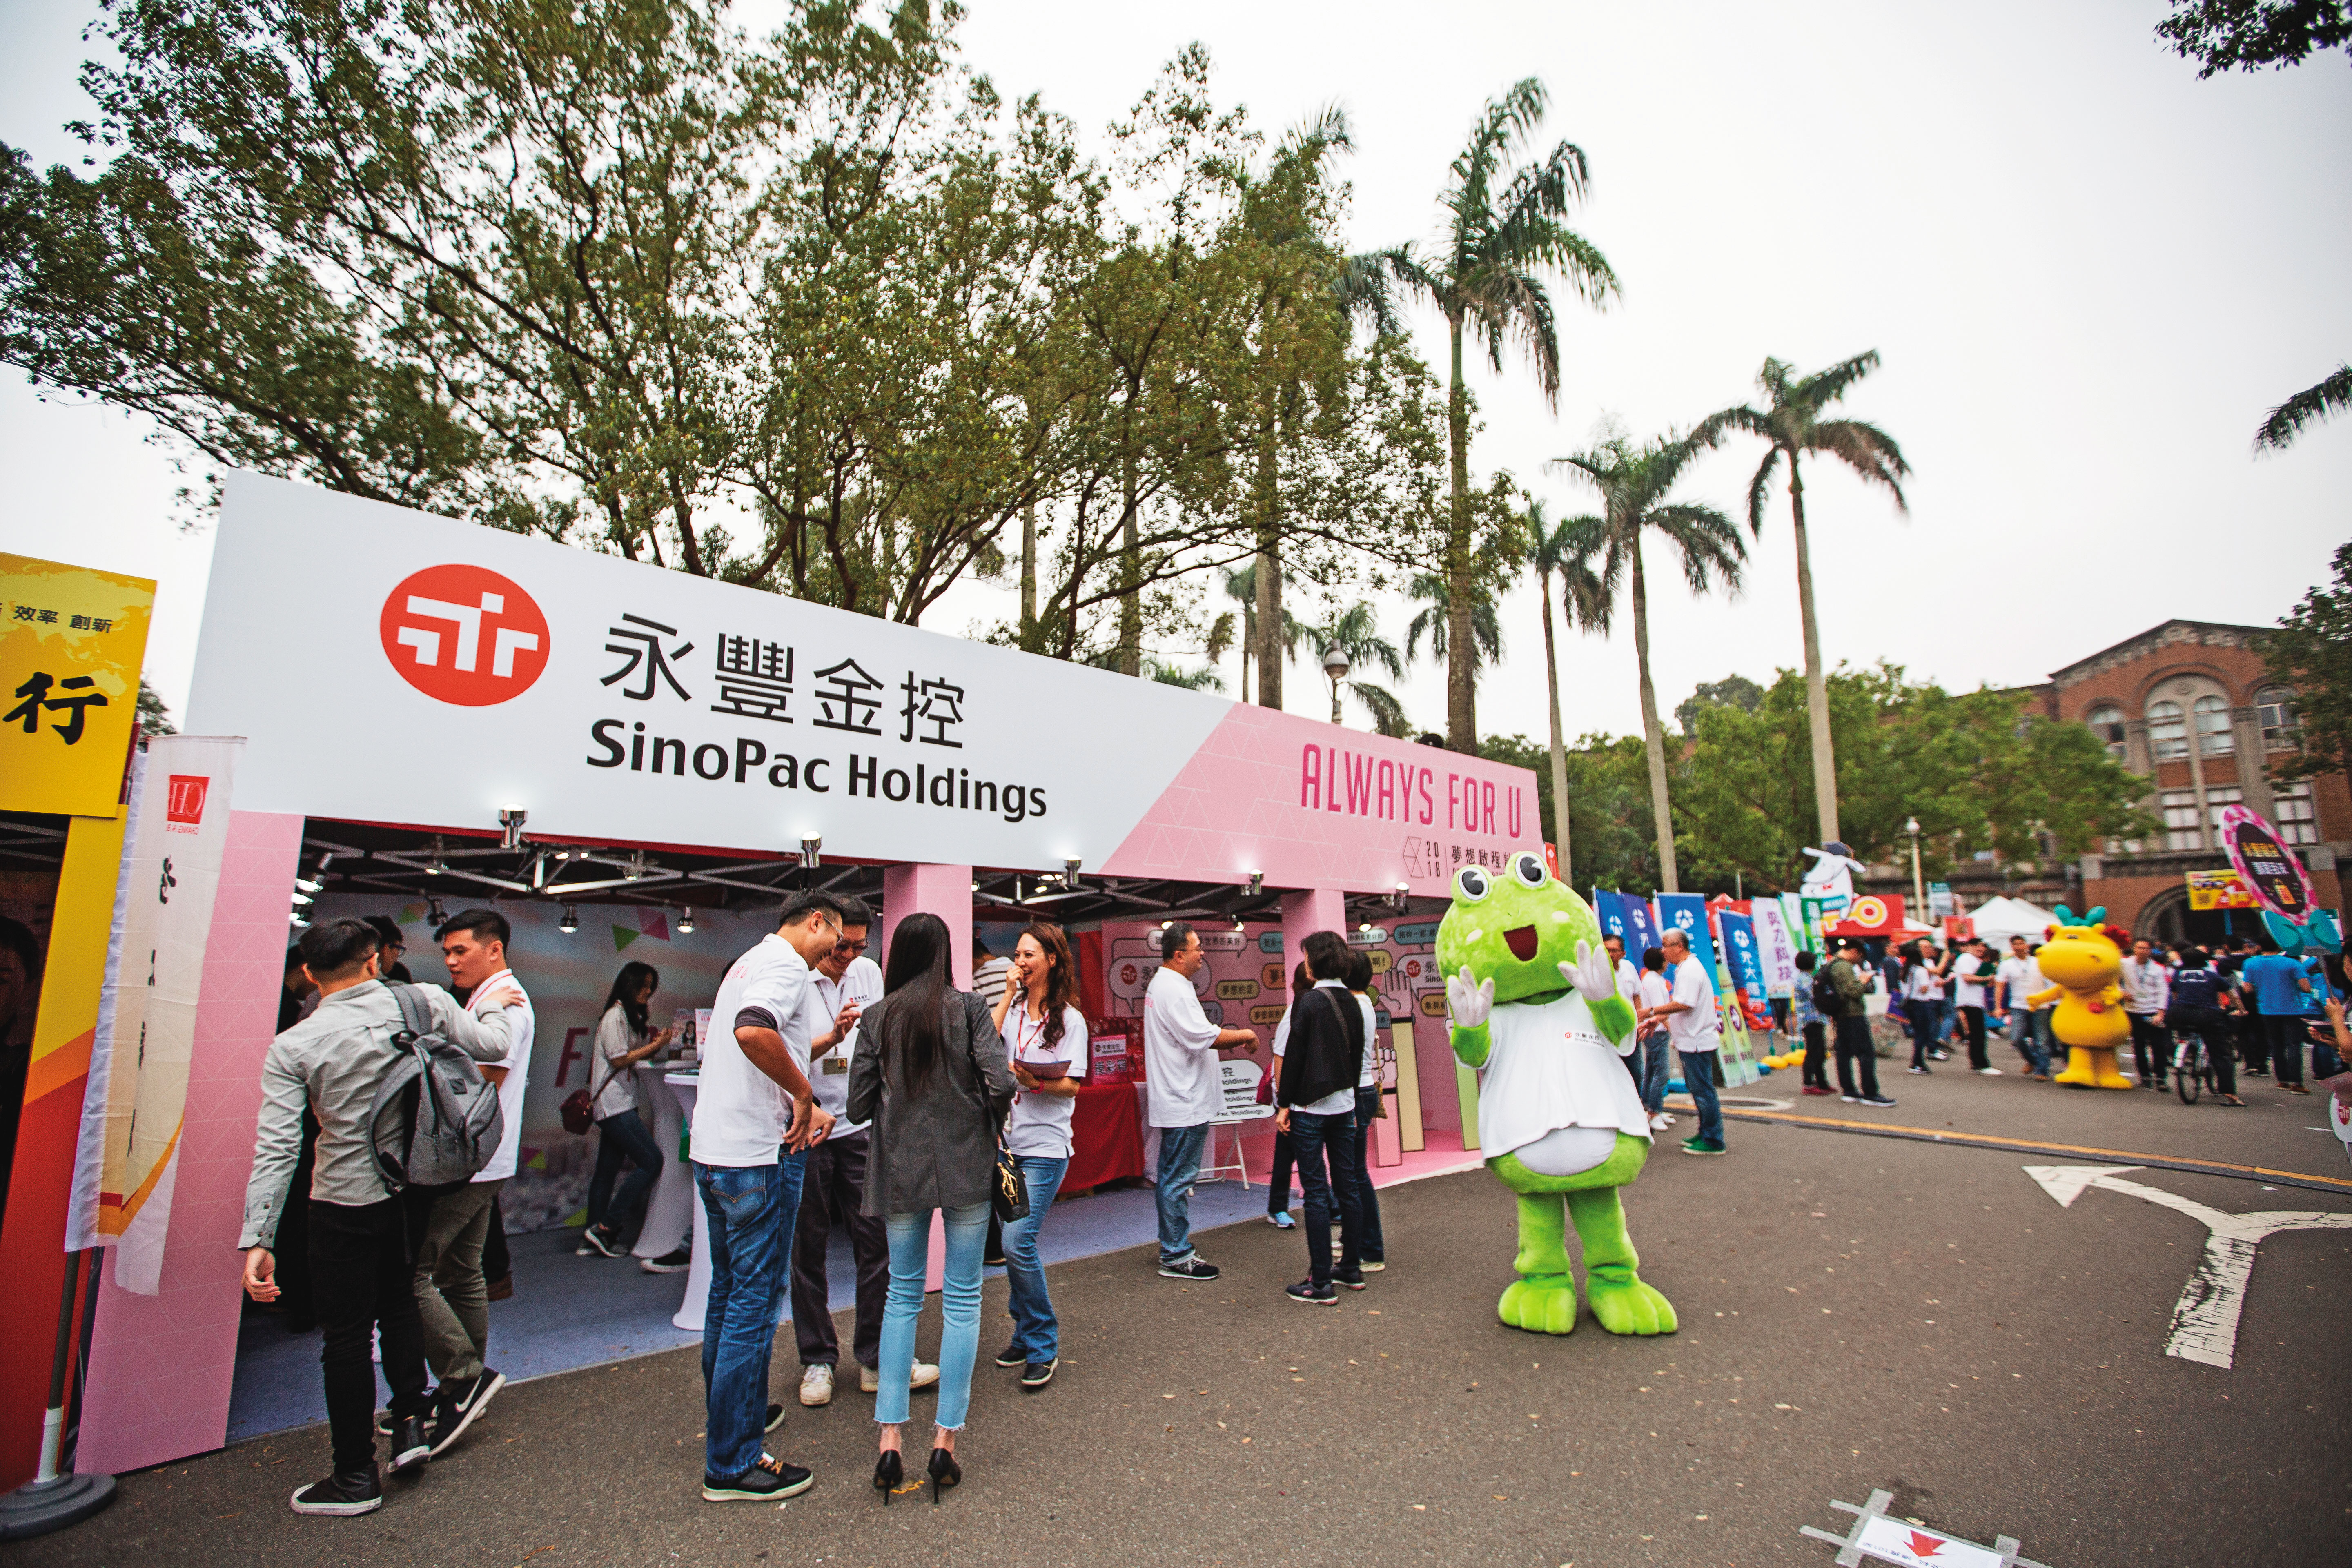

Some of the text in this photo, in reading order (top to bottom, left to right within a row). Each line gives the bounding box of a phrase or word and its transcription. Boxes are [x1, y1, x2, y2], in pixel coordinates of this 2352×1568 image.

[13, 605, 58, 624] 效率
[69, 614, 113, 634] 創新
[599, 613, 964, 749] 永豐金控
[586, 719, 1047, 823] SinoPac Holdings
[1301, 743, 1521, 839] ALWAYS FOR U
